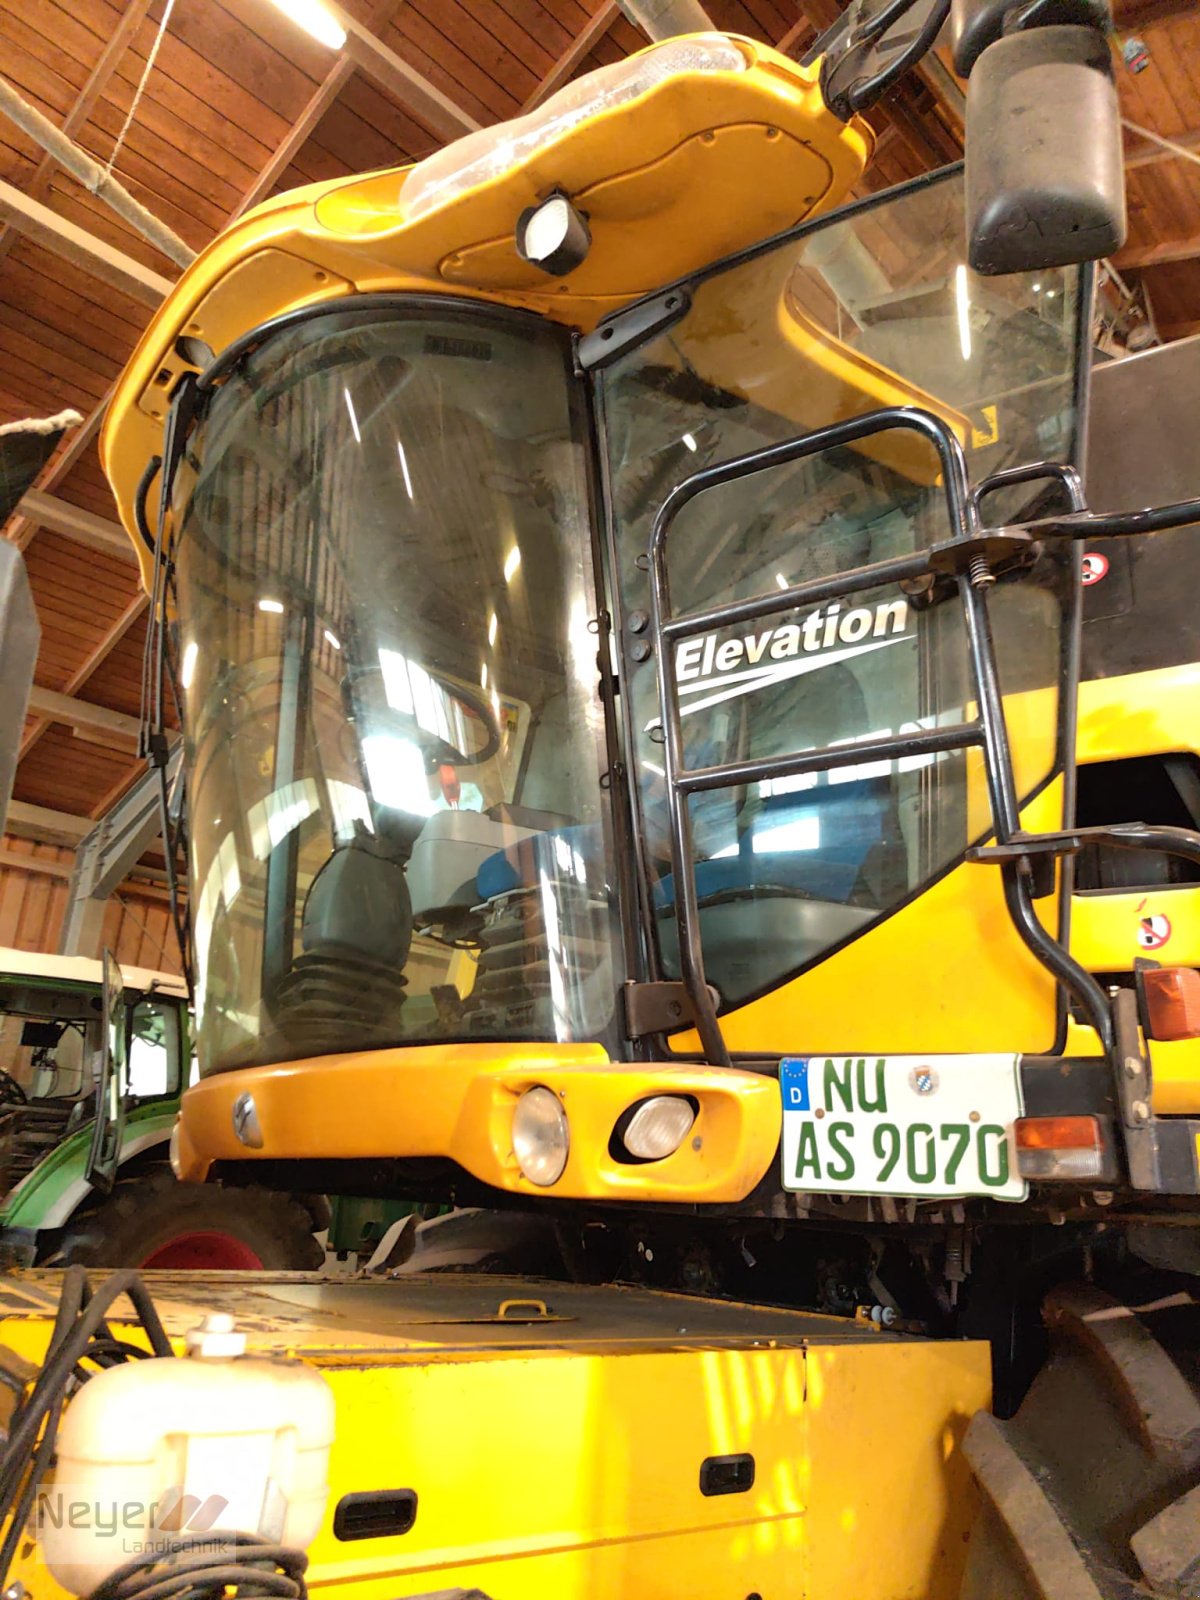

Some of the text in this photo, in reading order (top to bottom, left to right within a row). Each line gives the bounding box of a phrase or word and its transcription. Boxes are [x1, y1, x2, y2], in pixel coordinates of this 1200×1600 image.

[676, 599, 908, 682] Elevation
[790, 1087, 802, 1104] D
[823, 1058, 888, 1113] NU
[795, 1121, 1010, 1187] AS 9070
